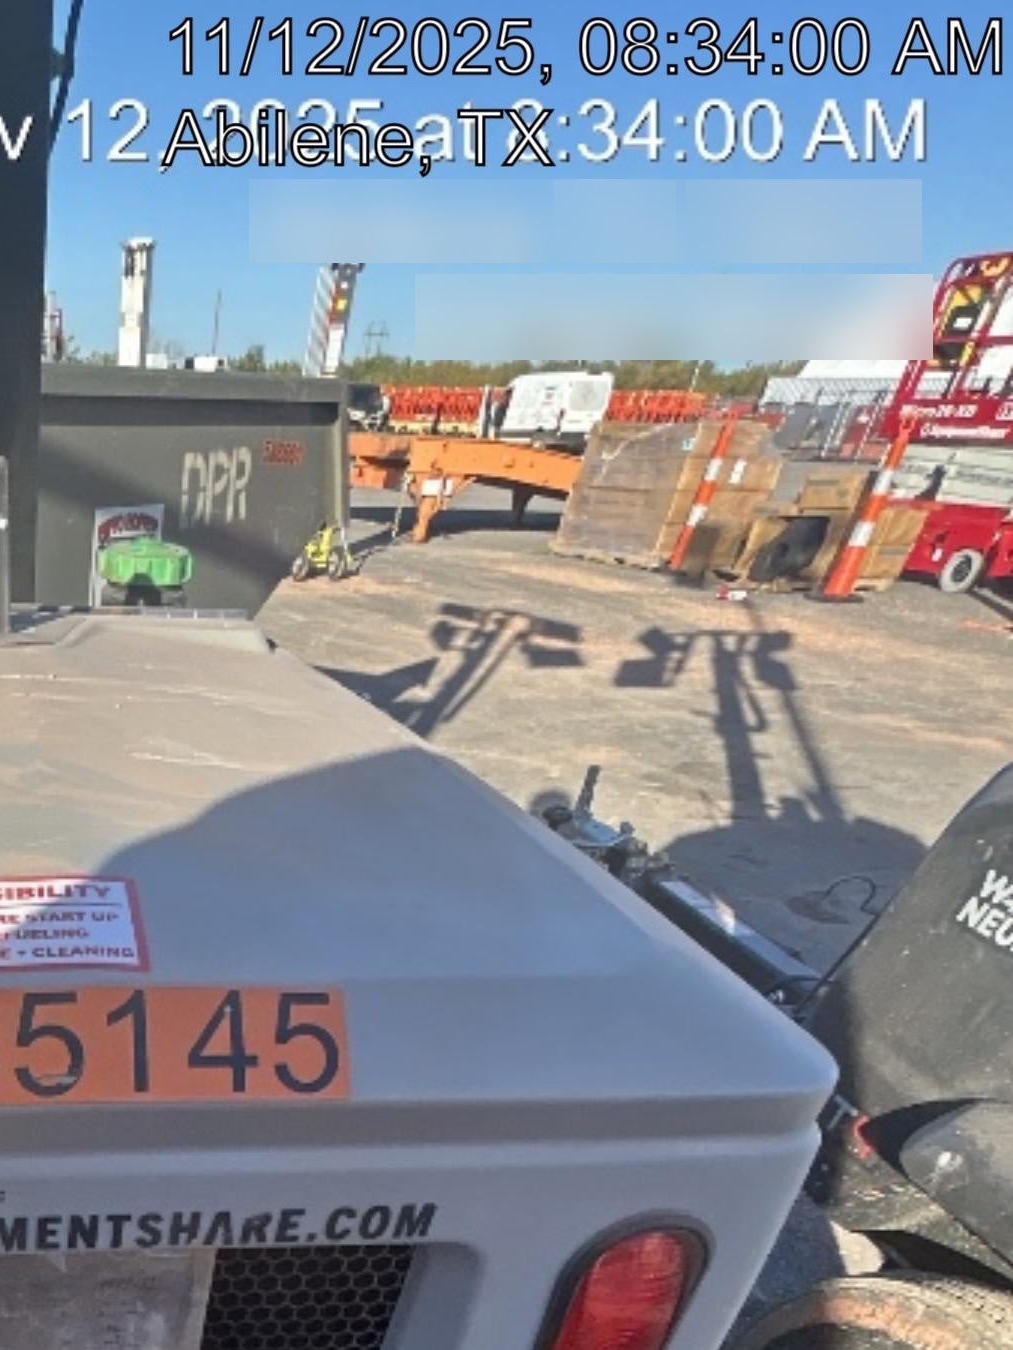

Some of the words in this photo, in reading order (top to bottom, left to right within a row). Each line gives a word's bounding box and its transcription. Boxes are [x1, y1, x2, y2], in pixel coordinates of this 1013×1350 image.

[26, 911, 86, 923] START
[91, 911, 119, 922] UP
[32, 946, 135, 958] CLEANING
